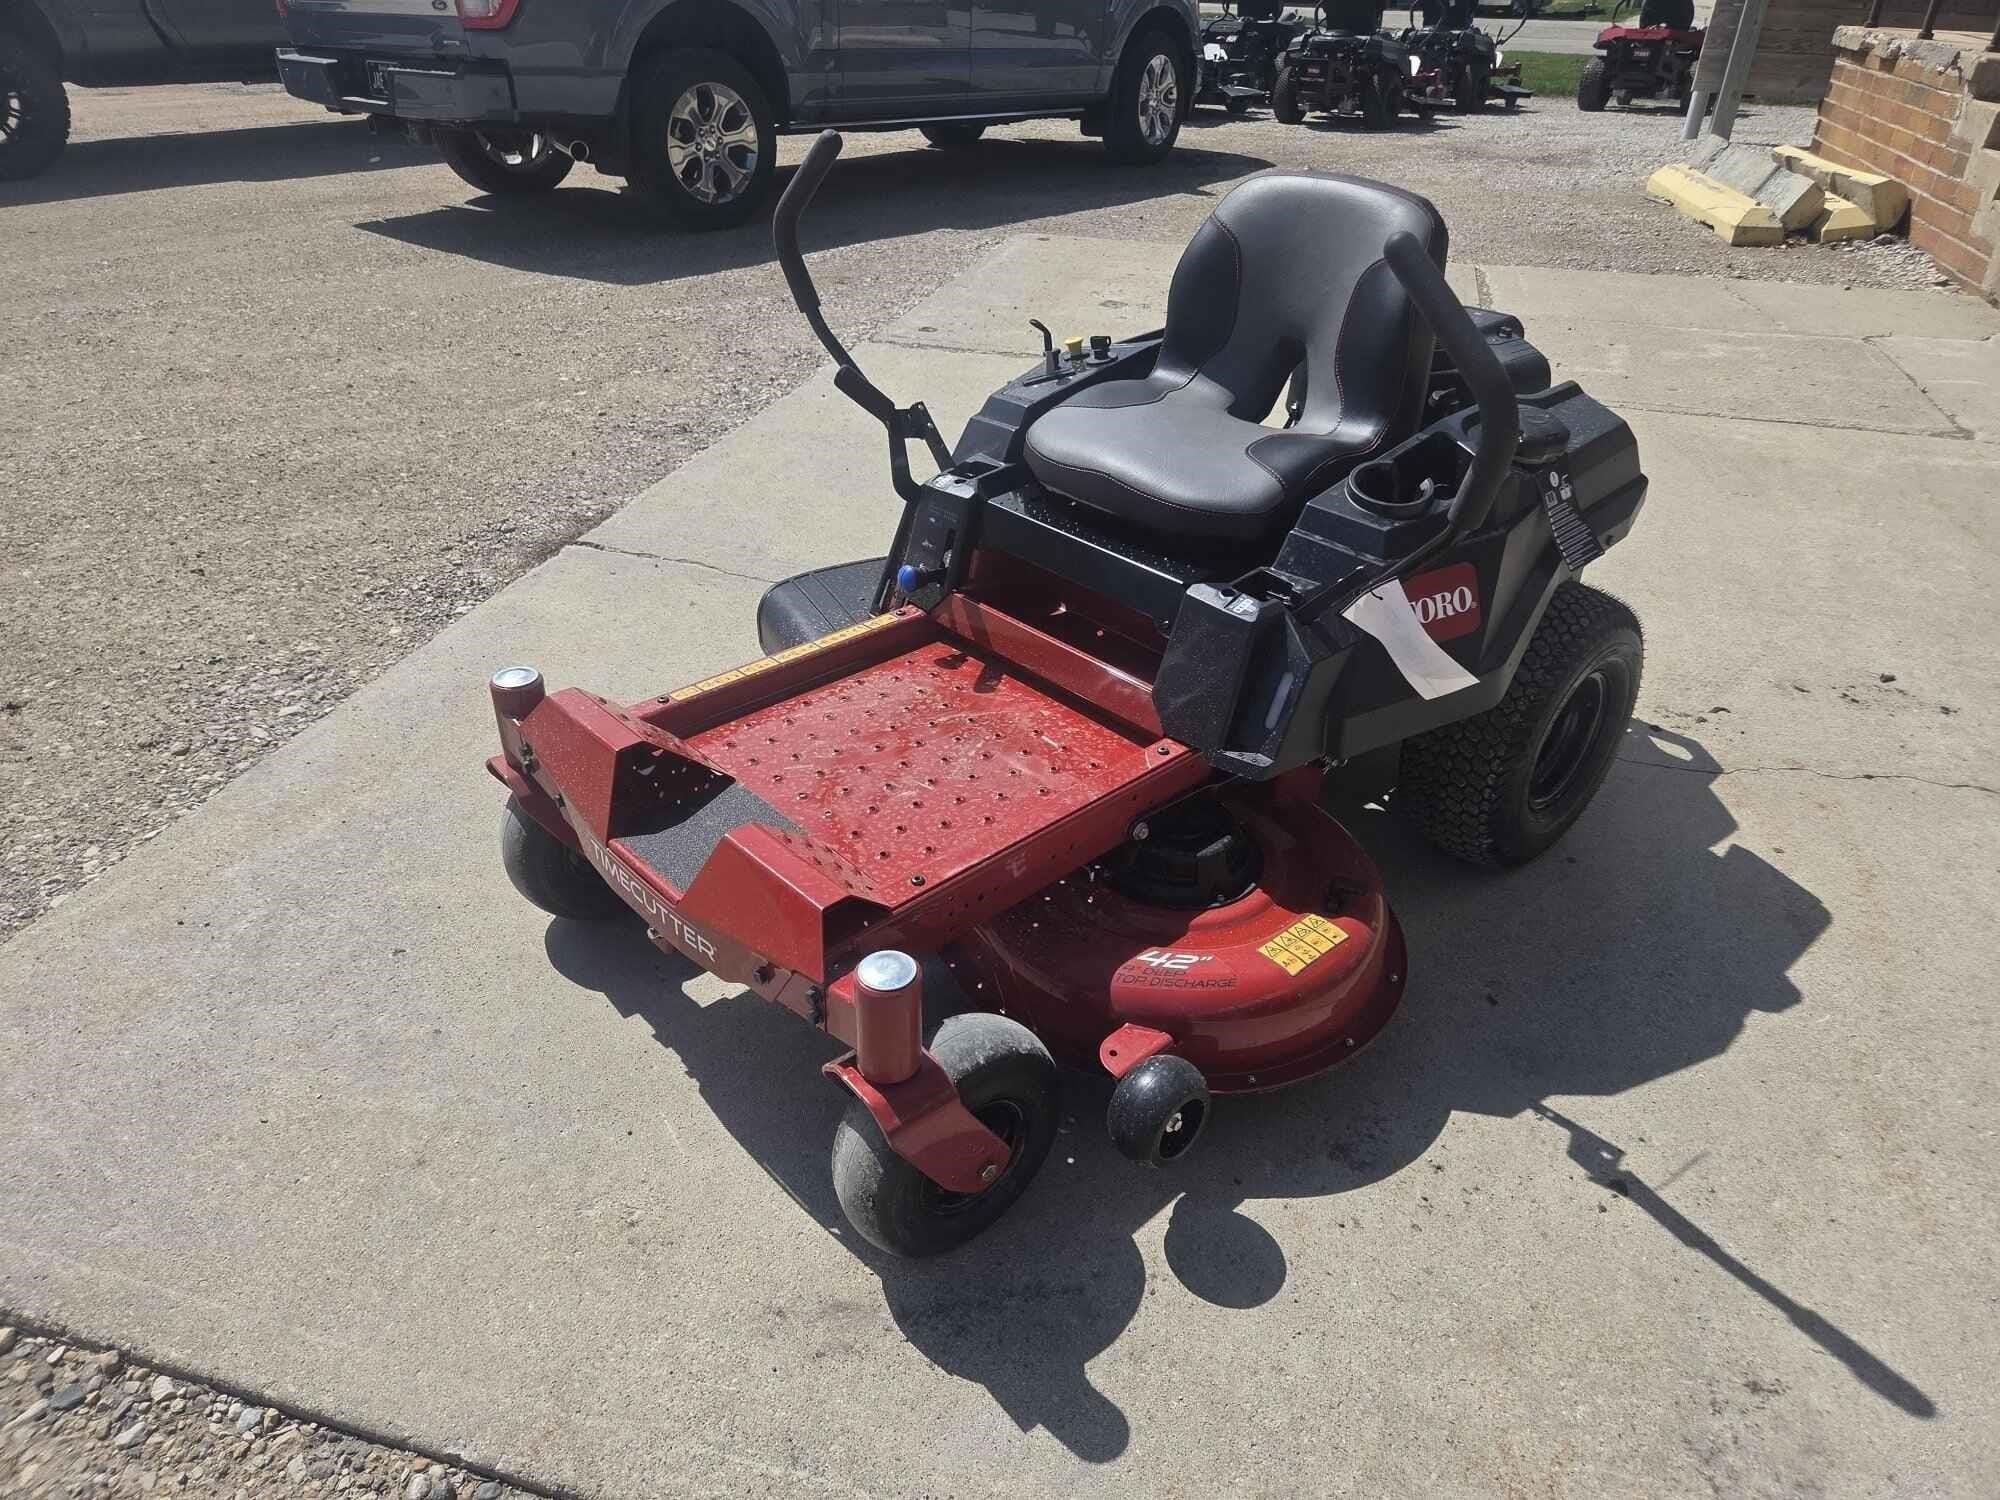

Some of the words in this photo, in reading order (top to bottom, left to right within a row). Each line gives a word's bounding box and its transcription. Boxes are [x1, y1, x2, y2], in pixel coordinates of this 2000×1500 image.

[591, 839, 716, 962] TIMECUTTER
[1136, 950, 1213, 970] 42"
[1116, 973, 1148, 984] TOP
[1151, 977, 1238, 989] DISCHARGE
